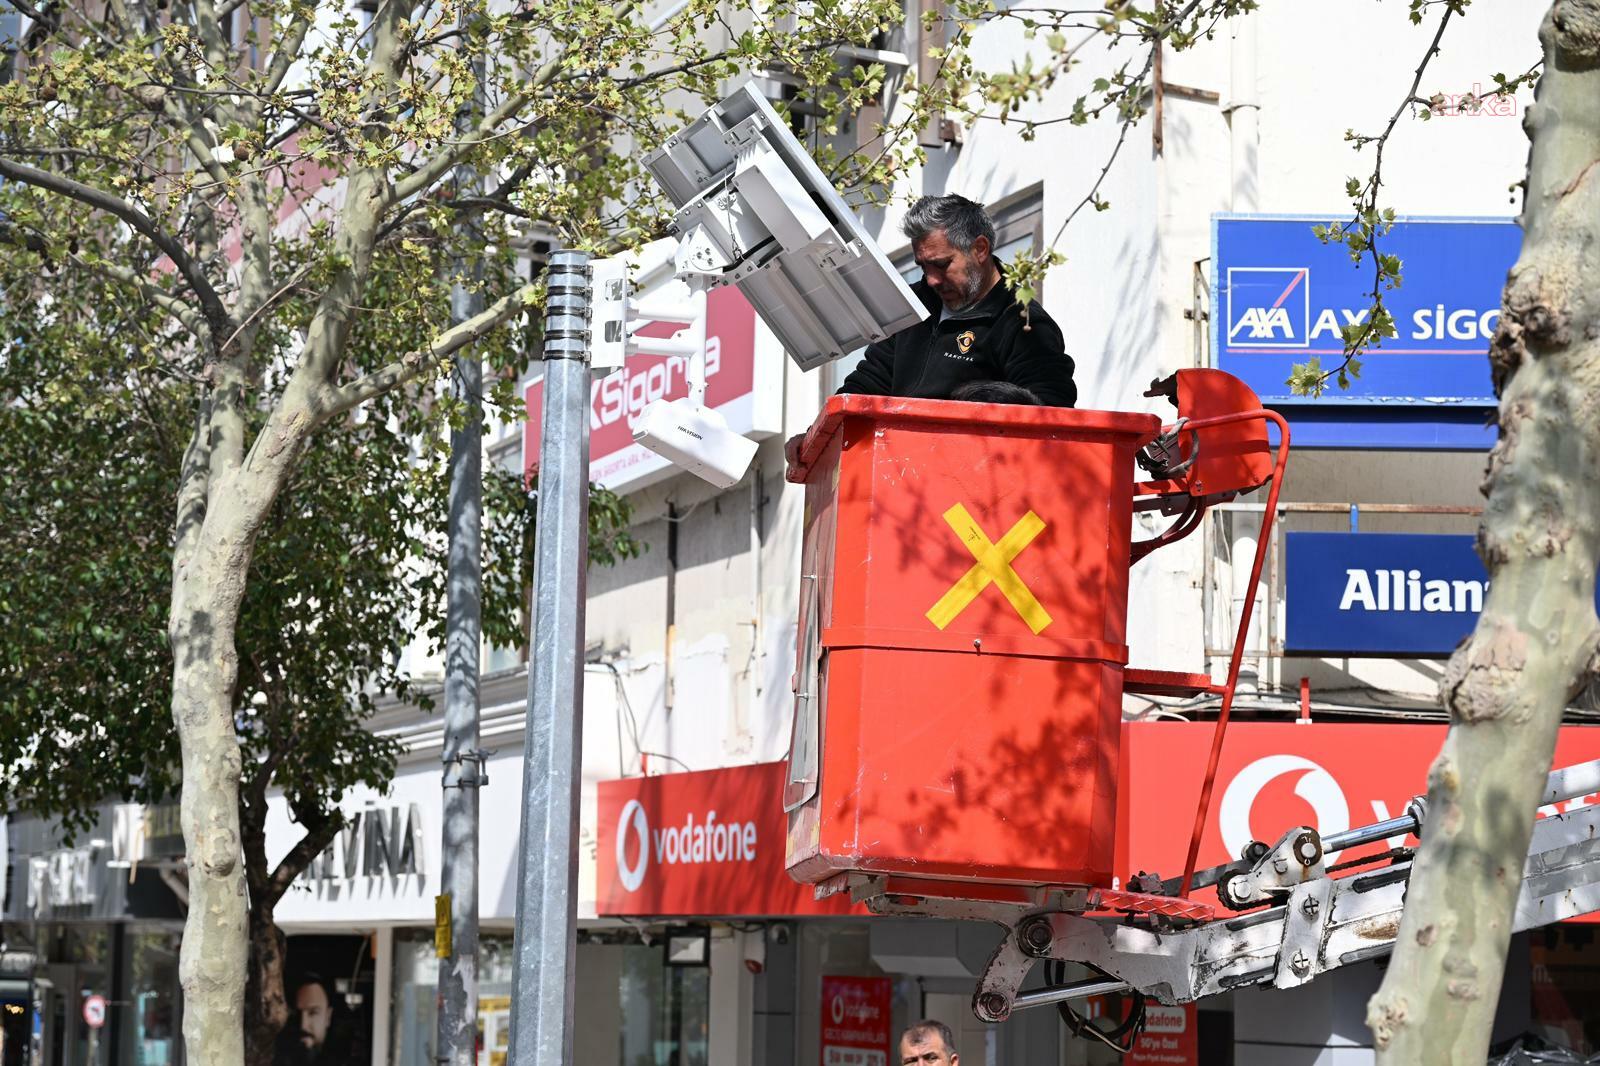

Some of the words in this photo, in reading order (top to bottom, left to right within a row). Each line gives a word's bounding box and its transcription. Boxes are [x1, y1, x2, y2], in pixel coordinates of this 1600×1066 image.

[1231, 307, 1295, 338] AXA
[1339, 569, 1490, 612] Allian
[654, 810, 757, 864] vodafone
